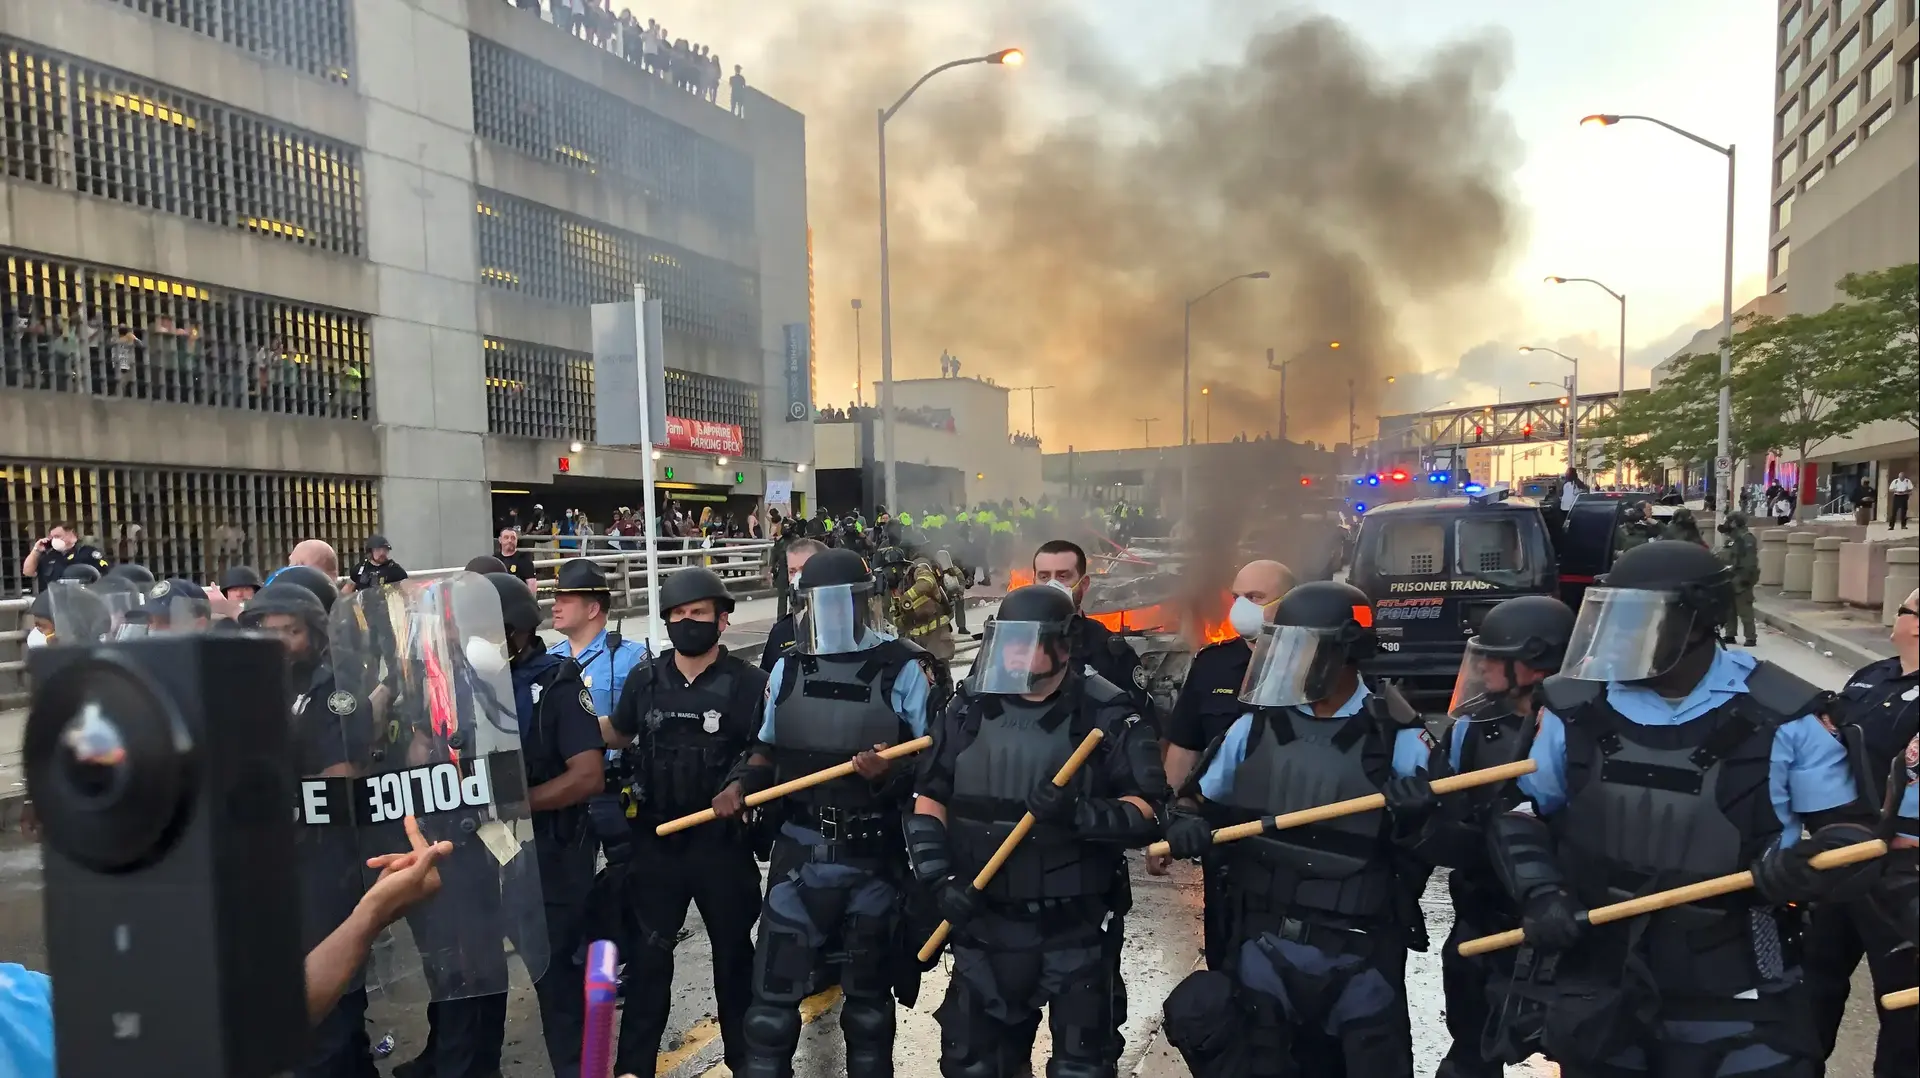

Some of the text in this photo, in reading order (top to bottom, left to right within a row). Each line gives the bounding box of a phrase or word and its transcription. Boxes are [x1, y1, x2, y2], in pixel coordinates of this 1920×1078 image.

[666, 421, 684, 435] Farm
[697, 422, 731, 438] SAPPHIRE
[690, 436, 740, 452] PARKING DECK
[1390, 580, 1500, 592] PRISONER TRANS
[1376, 598, 1444, 607] ATLANTA
[1376, 606, 1442, 619] POLICE
[366, 758, 490, 823] POLICE
